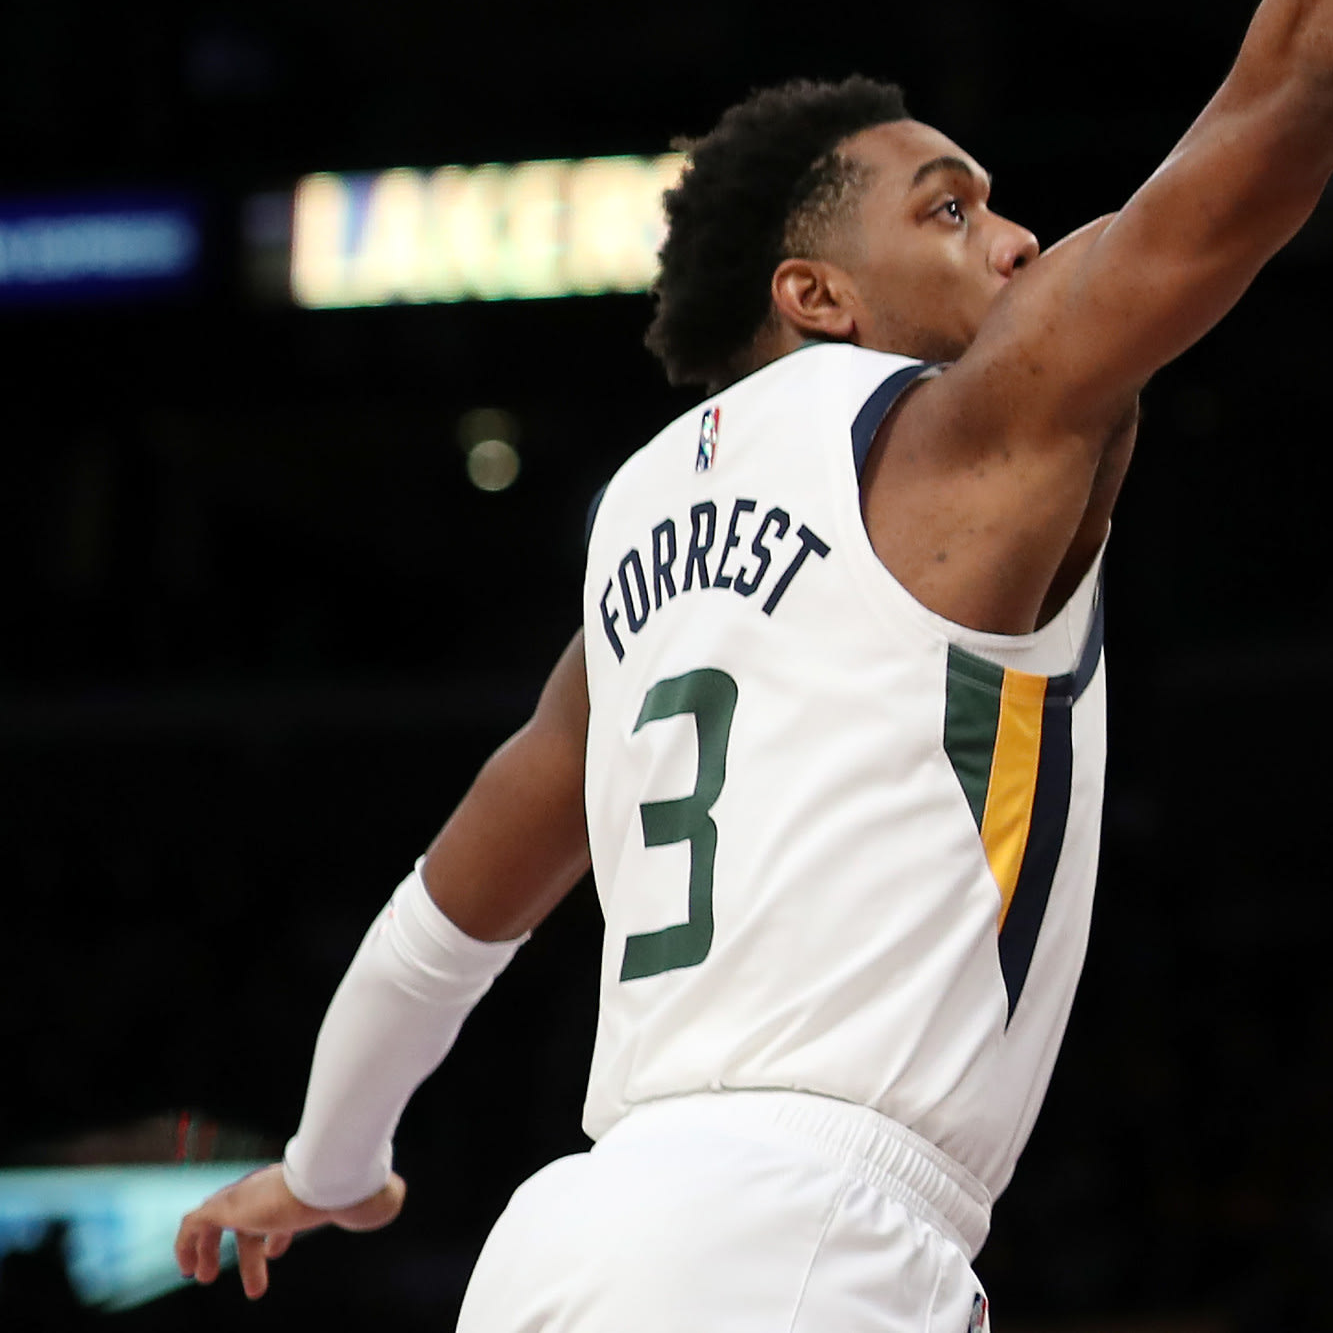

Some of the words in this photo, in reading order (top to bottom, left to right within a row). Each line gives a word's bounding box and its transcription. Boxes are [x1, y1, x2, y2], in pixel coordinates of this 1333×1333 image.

[291, 152, 692, 310] LAKER
[600, 499, 831, 663] FORREST
[619, 668, 738, 982] 3
